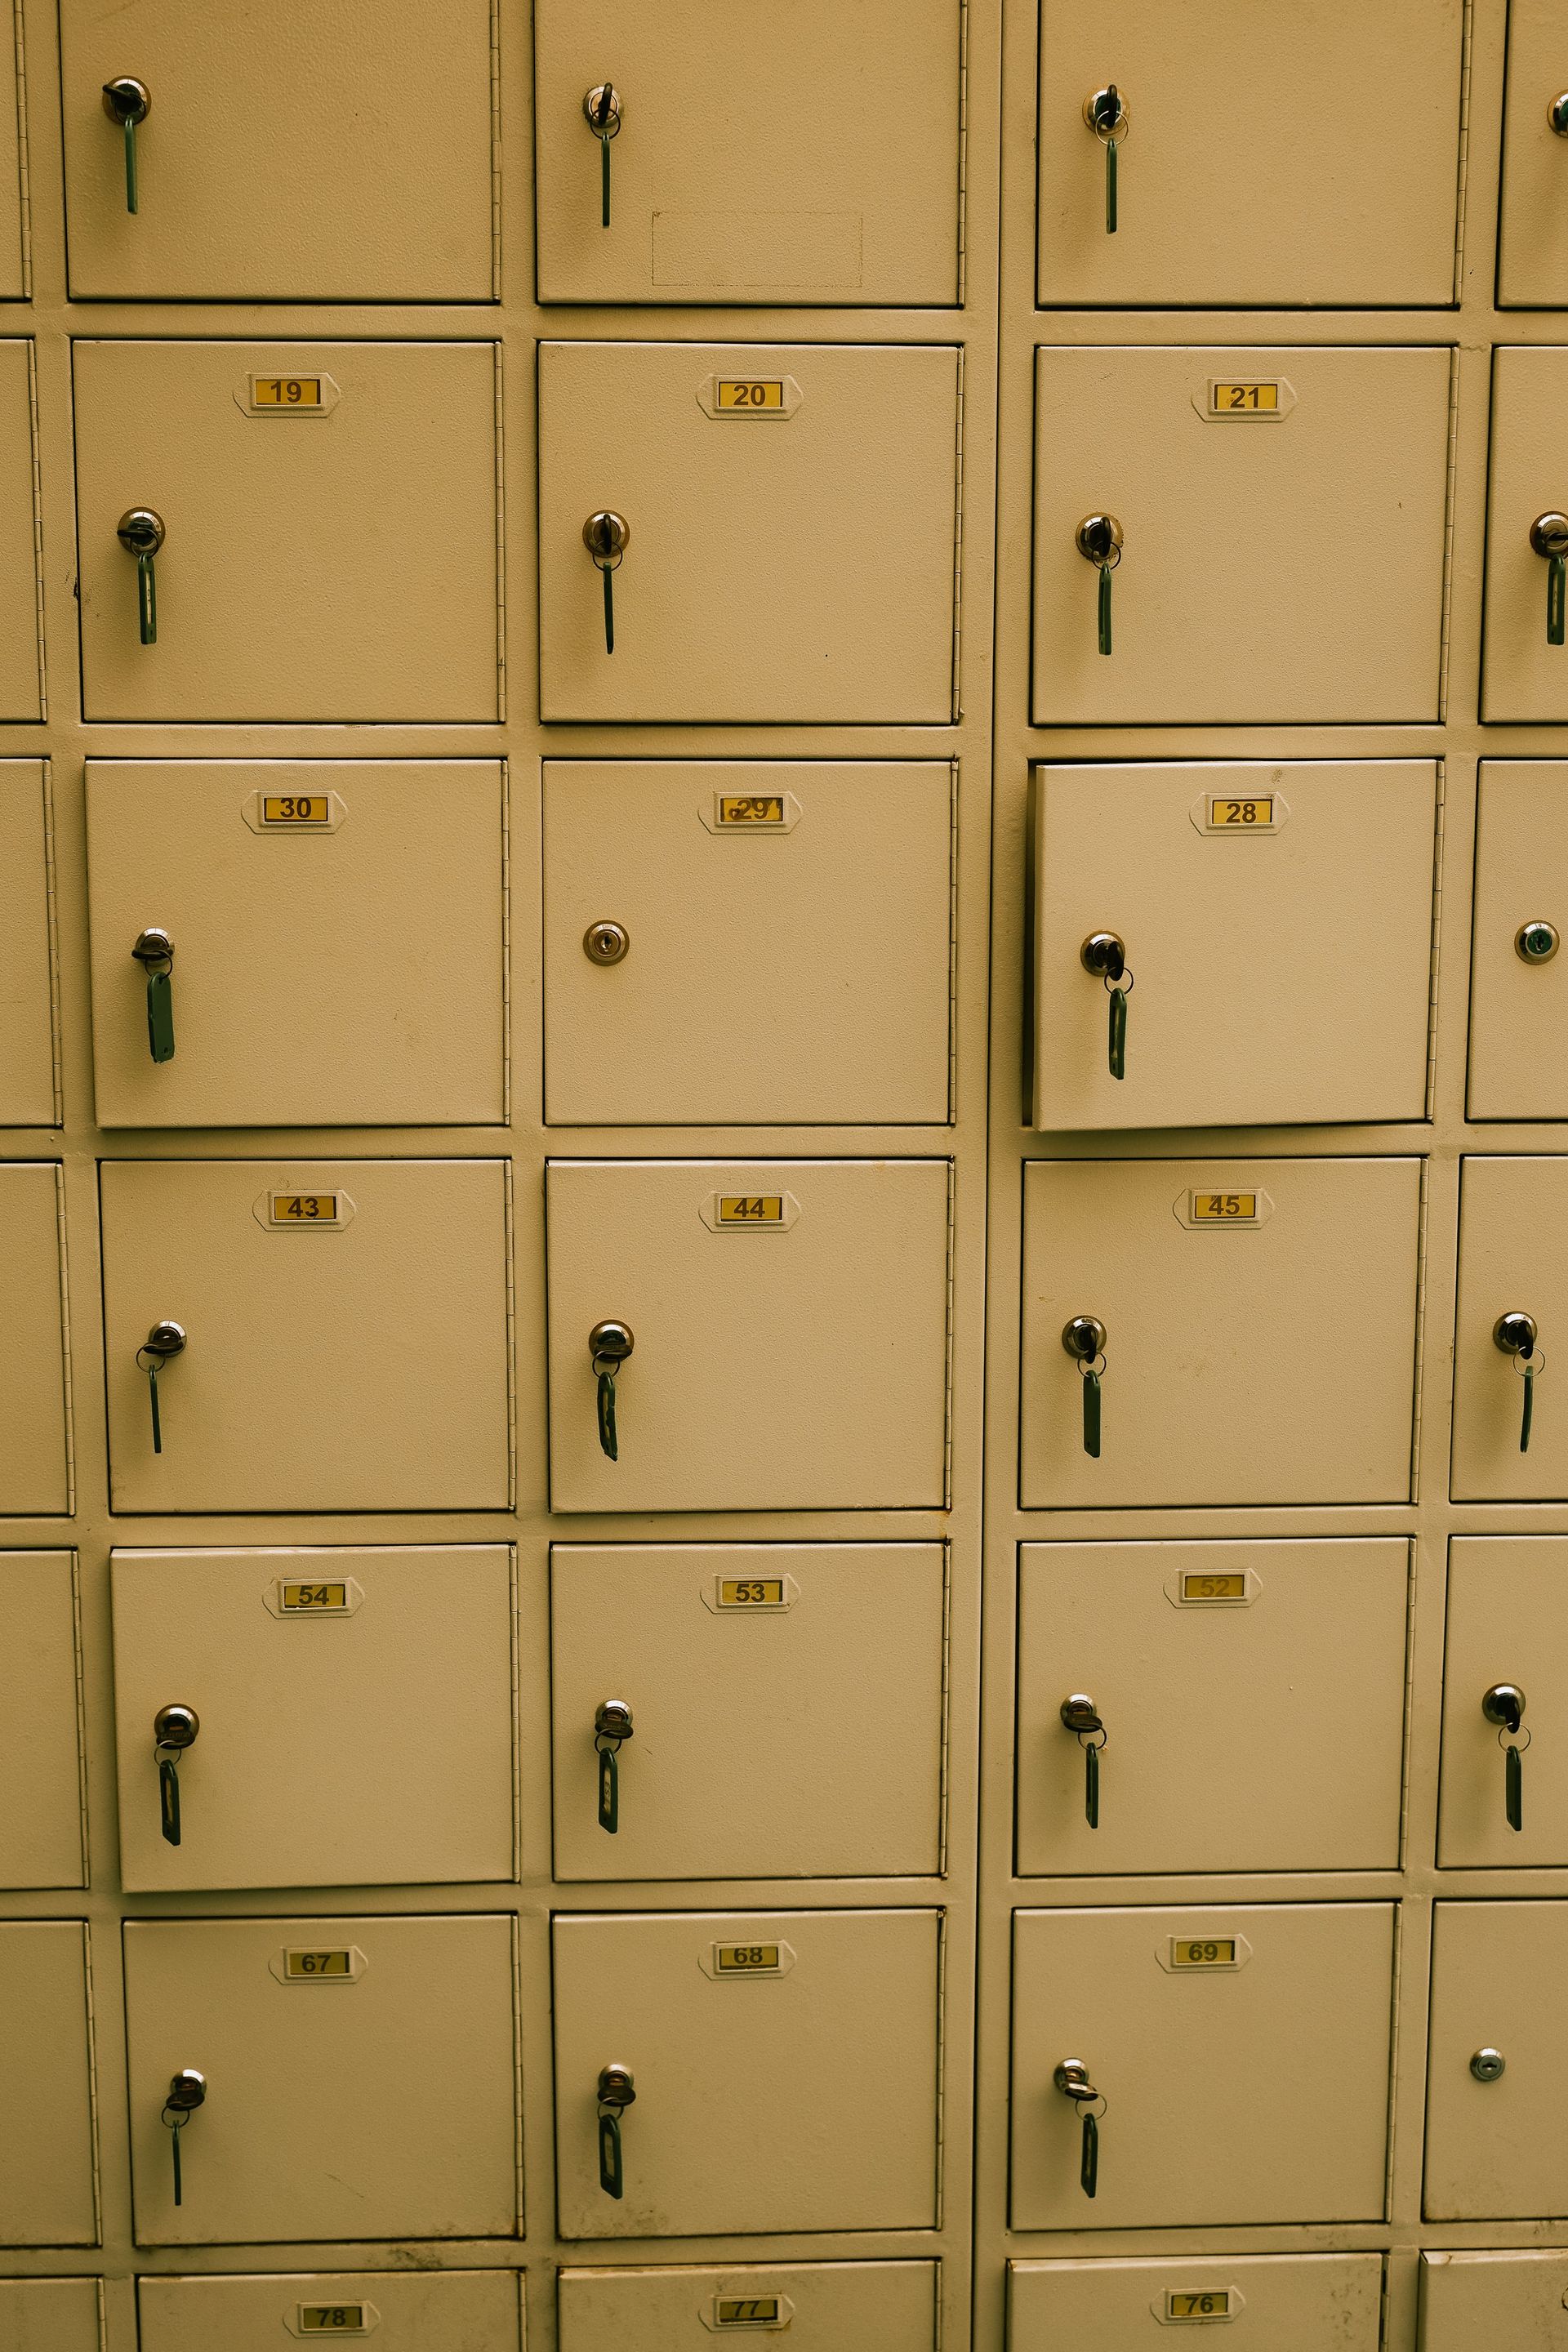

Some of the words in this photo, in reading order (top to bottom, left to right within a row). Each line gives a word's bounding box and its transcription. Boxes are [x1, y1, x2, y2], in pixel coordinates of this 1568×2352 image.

[270, 381, 301, 403] 19
[733, 385, 766, 406] 20
[1230, 387, 1258, 408] 21
[280, 798, 311, 818] 30
[737, 800, 768, 819] 29
[1226, 803, 1256, 823] 28
[287, 1198, 319, 1217] 43
[733, 1198, 765, 1218] 44
[1209, 1196, 1240, 1215] 45
[298, 1586, 329, 1606] 54
[735, 1584, 765, 1602] 53
[1200, 1579, 1230, 1597] 52
[733, 1948, 763, 1964] 68
[1188, 1944, 1218, 1961] 69
[301, 1954, 331, 1972] 67
[732, 2301, 760, 2318] 77
[1186, 2296, 1214, 2314] 76
[317, 2310, 346, 2327] 78
